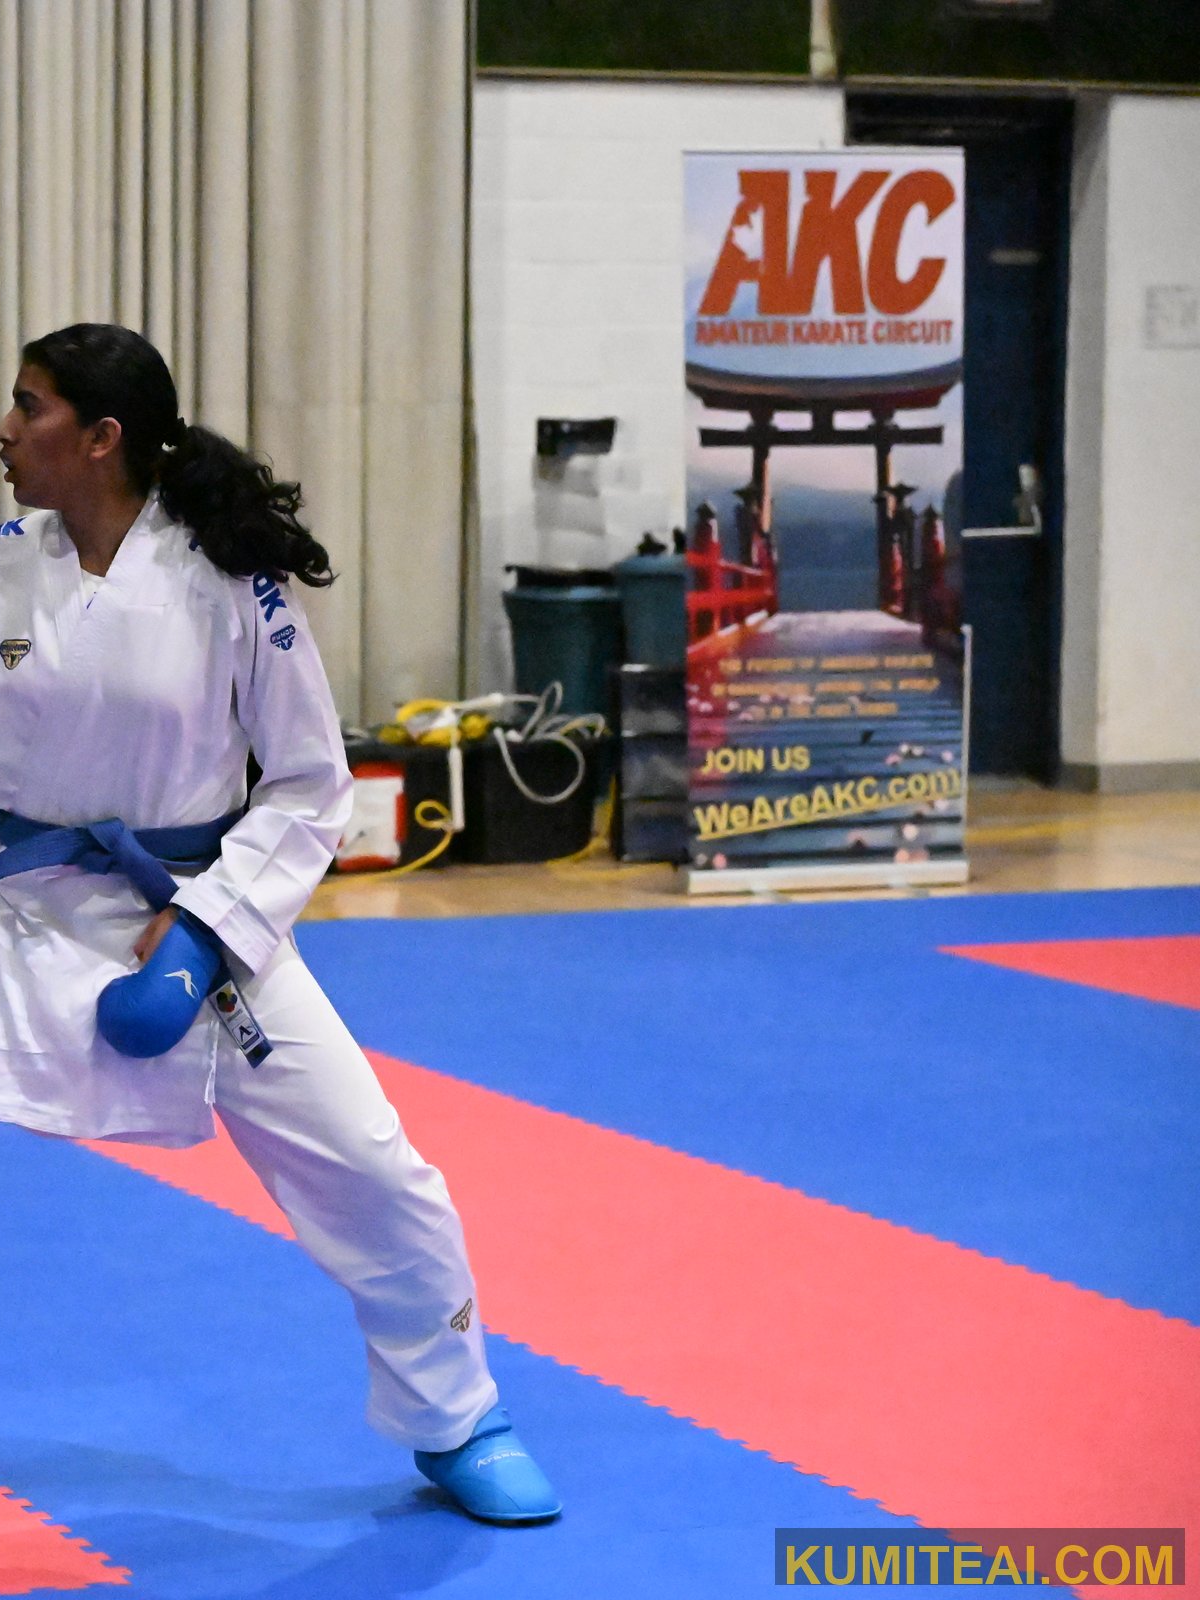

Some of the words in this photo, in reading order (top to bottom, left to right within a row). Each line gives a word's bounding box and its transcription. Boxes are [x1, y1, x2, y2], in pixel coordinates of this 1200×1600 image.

[697, 169, 956, 316] AKC
[695, 319, 789, 345] AMATEUR
[794, 319, 867, 345] KARATE
[873, 319, 953, 345] CIRCUIT
[701, 747, 765, 775] JOIN
[771, 745, 811, 771] US
[693, 767, 961, 835] WeAreAKC.com
